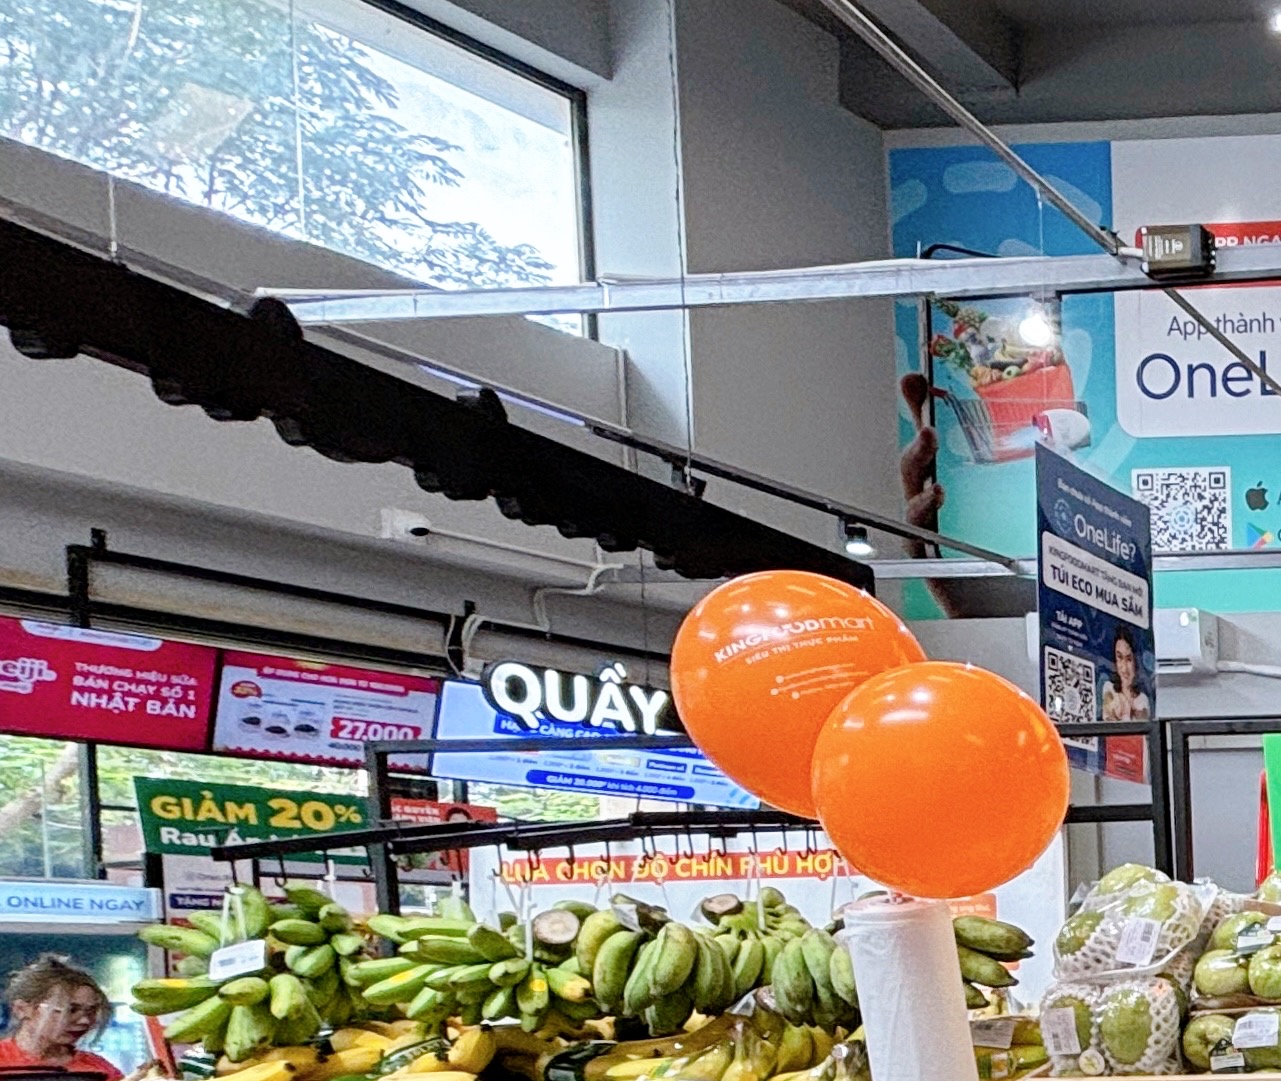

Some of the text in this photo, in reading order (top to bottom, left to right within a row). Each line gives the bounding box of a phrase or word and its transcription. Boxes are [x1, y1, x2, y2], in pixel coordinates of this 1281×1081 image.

[1215, 236, 1239, 248] PP
[1167, 315, 1206, 338] App
[1215, 312, 1276, 335] thành
[1074, 513, 1136, 562] OneLife?
[1072, 576, 1092, 597] ECO
[1095, 585, 1119, 609] MUA
[72, 674, 109, 690] BÁN
[160, 686, 183, 699] SỐ
[490, 662, 667, 736] QUẦY
[70, 691, 196, 719] NHẬT BẢN
[151, 790, 362, 832] GIẢM 20%
[160, 826, 217, 847] Rau
[557, 856, 626, 884] CHỌN
[675, 851, 733, 877] CHÍN
[741, 848, 789, 877] PHÙ
[7, 895, 145, 911] ONLINE NGAY
